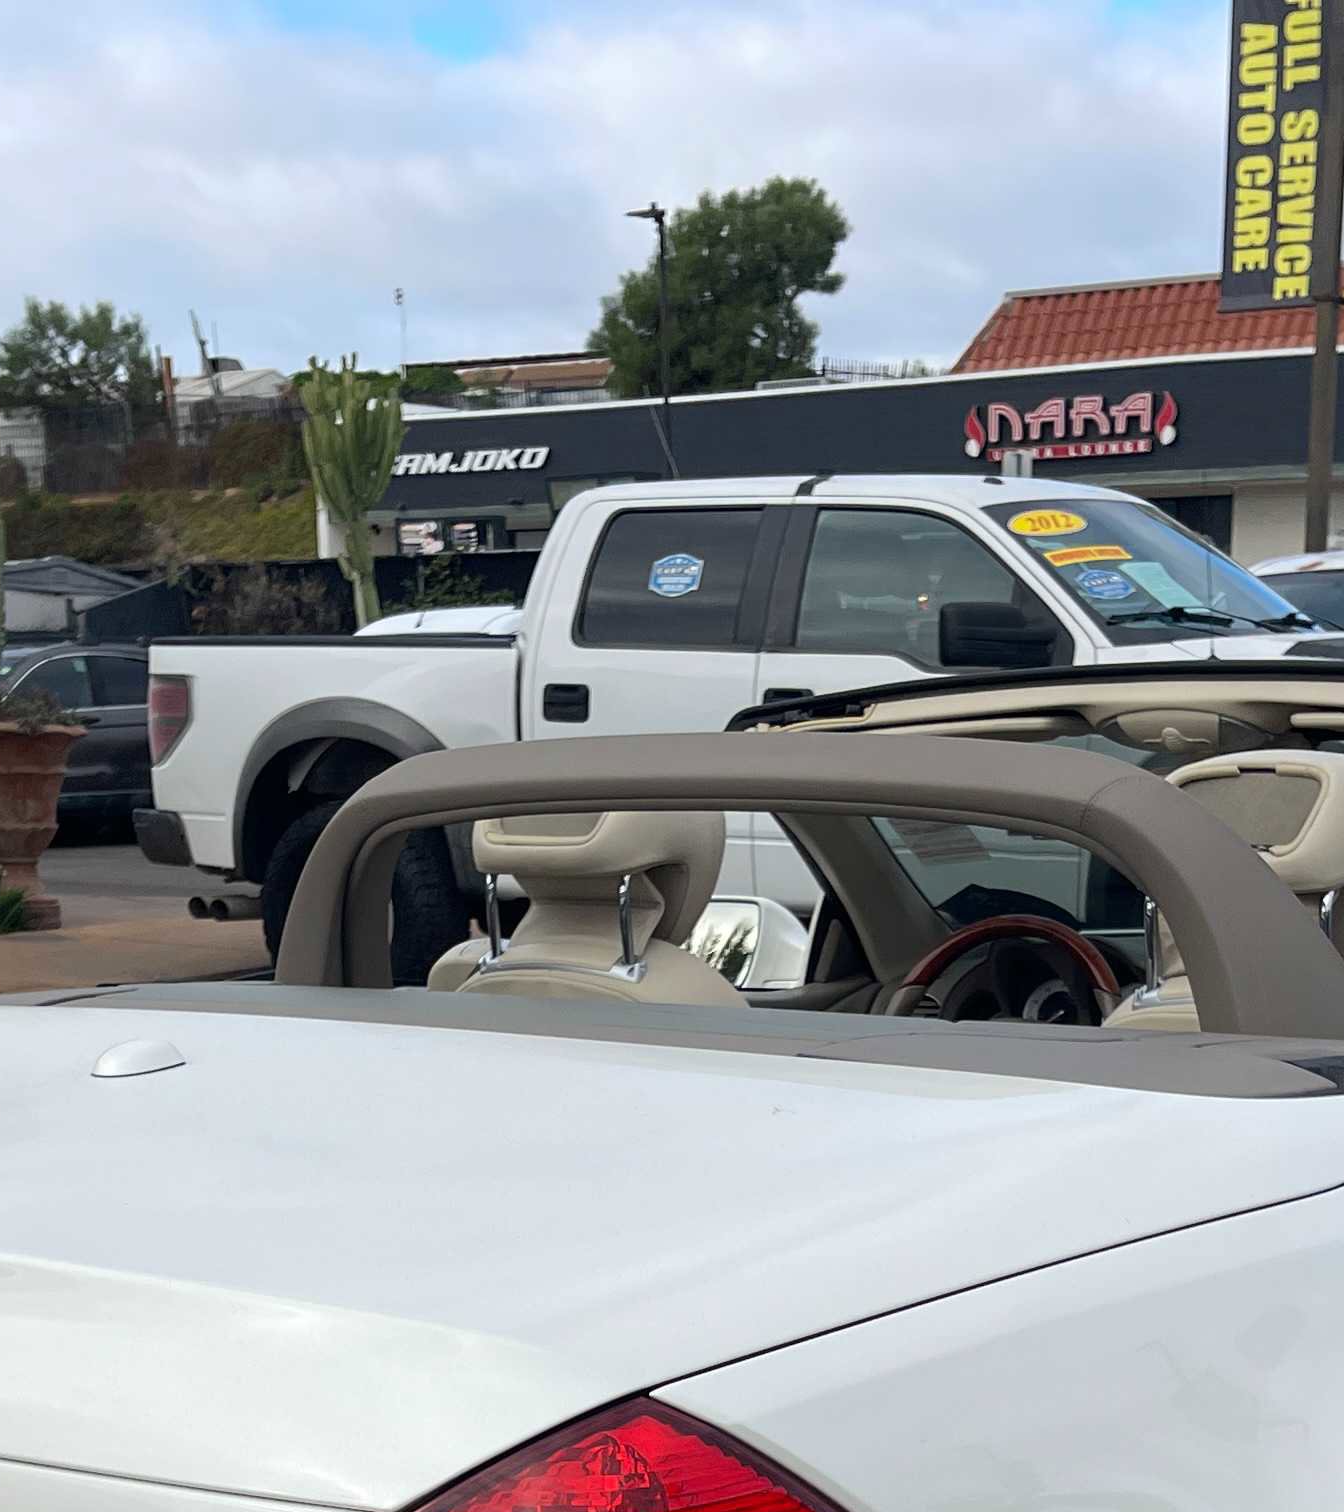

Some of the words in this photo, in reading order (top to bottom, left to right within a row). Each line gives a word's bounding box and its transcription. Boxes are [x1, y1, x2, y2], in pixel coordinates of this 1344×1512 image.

[1236, 23, 1278, 146] AUTO
[1232, 154, 1274, 273] CARE
[1272, 109, 1319, 300] SERVICE
[987, 390, 1152, 443] NARA
[1025, 513, 1075, 533] 2012
